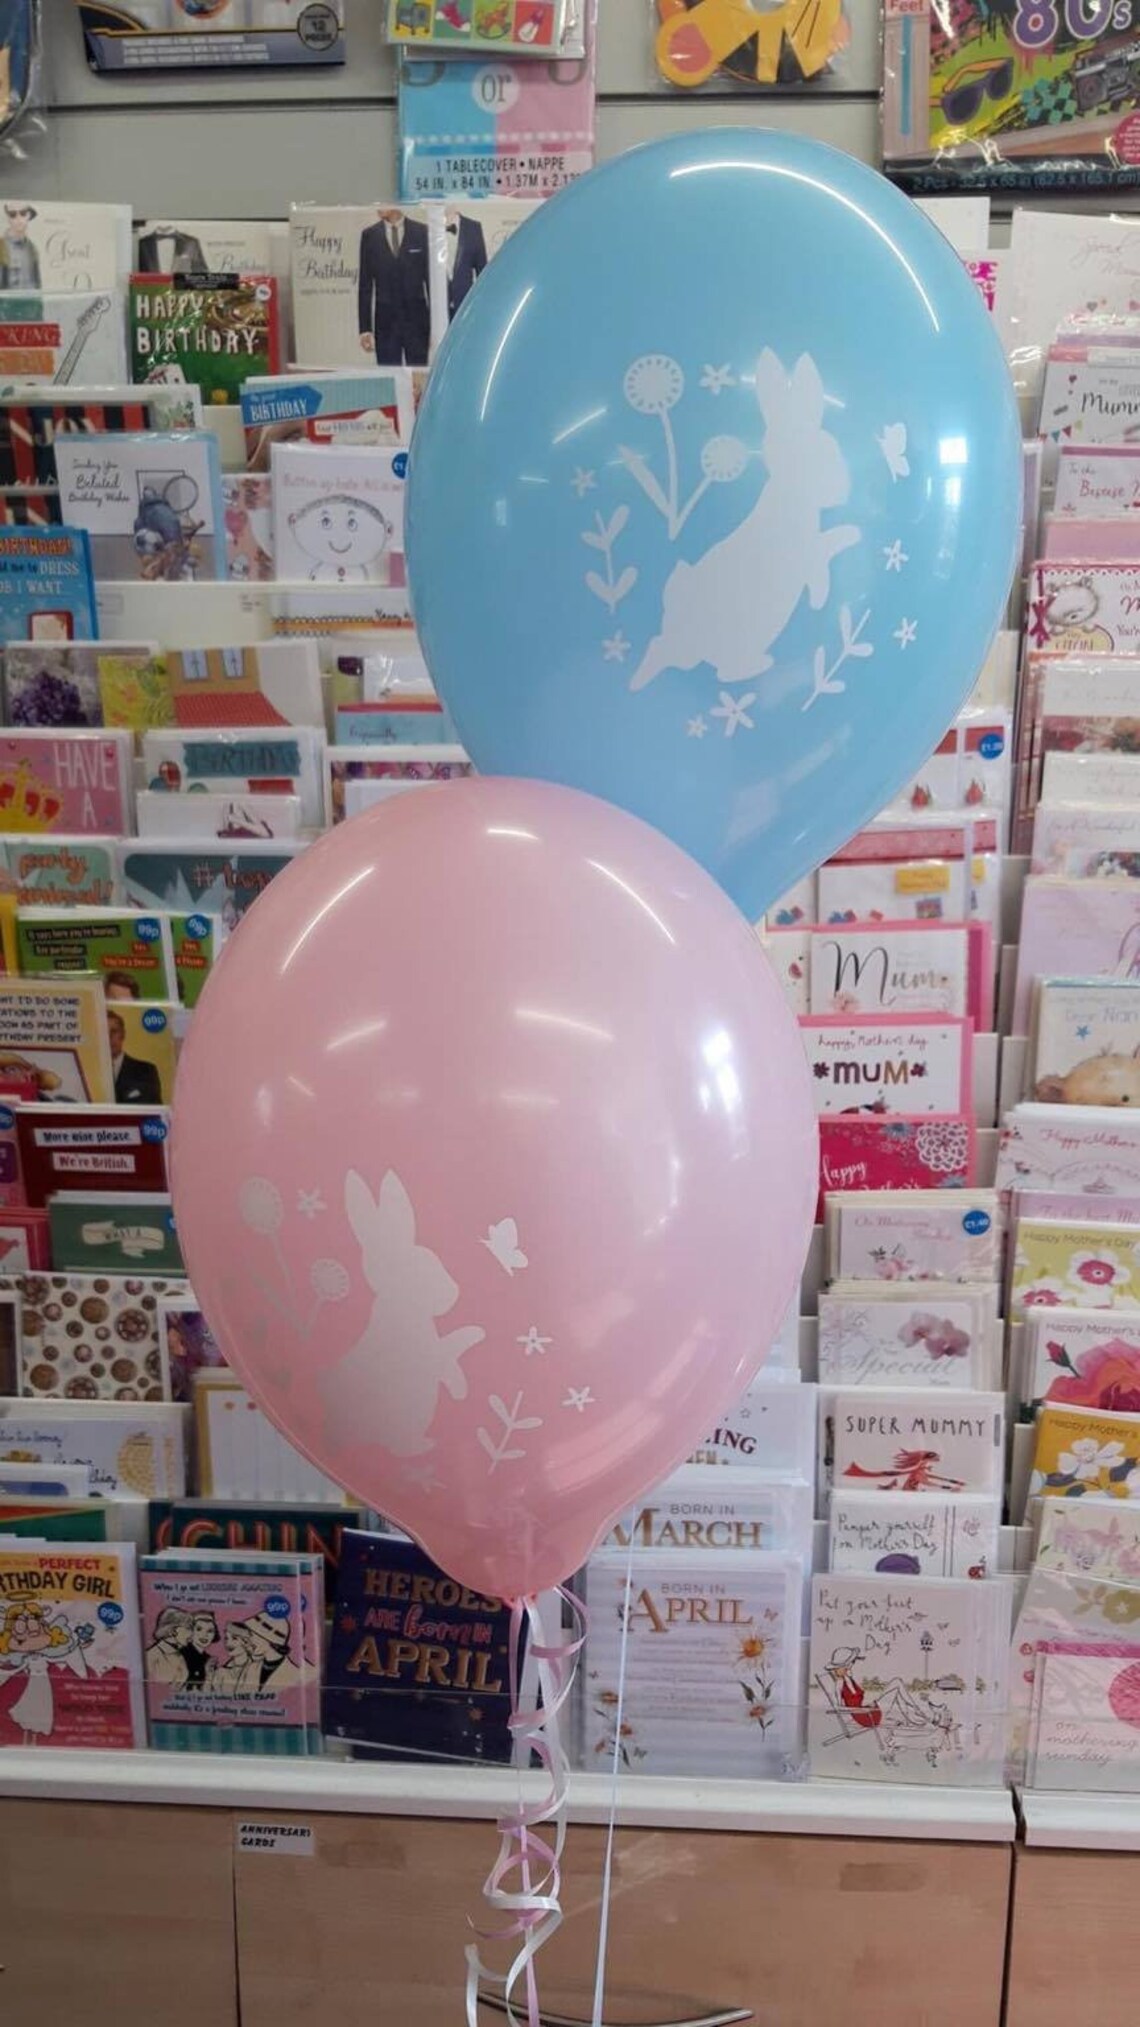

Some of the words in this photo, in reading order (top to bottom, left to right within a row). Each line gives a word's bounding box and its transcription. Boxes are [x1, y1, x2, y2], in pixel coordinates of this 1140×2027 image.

[481, 74, 513, 103] or
[447, 158, 517, 173] TABLECOVER
[528, 157, 565, 171] NAPPE
[416, 179, 428, 190] 54
[461, 177, 474, 189] 84
[506, 174, 539, 188] 1.37M
[293, 225, 345, 252] Happy
[303, 256, 359, 284] Birthday
[136, 294, 204, 319] HAPPY
[136, 325, 258, 355] BIRTHDAY
[251, 398, 308, 422] BIRTHDAY
[76, 473, 121, 490] Belated
[53, 741, 116, 791] HAVE
[84, 791, 97, 828] A
[821, 940, 936, 1006] Mum
[40, 1009, 55, 1018] TO
[59, 1009, 77, 1018] THE
[43, 1131, 69, 1143] More
[72, 1132, 93, 1143] wine
[59, 1155, 90, 1168] We're
[1024, 1233, 1059, 1245] Happy
[1063, 1234, 1113, 1247] Mother's
[1045, 1322, 1083, 1335] Happy
[845, 1415, 901, 1435] SUPER
[911, 1417, 985, 1437] MUMMY
[1049, 1418, 1086, 1434] Happy
[669, 1503, 713, 1516] BORN
[719, 1504, 735, 1516] IN
[602, 1507, 765, 1548] MARCH
[38, 1557, 102, 1571] PERFECT
[72, 1574, 116, 1599] GIRL
[363, 1567, 502, 1613] HEROES
[661, 1583, 704, 1595] BORN
[709, 1583, 726, 1595] IN
[100, 1606, 121, 1622] 99p
[619, 1588, 755, 1633] APRIL
[363, 1607, 400, 1632] ARE
[403, 1603, 472, 1644] born
[473, 1621, 493, 1644] IN
[864, 1633, 891, 1656] Day
[346, 1634, 502, 1693] APRIL
[241, 1837, 277, 1848] CARDS
